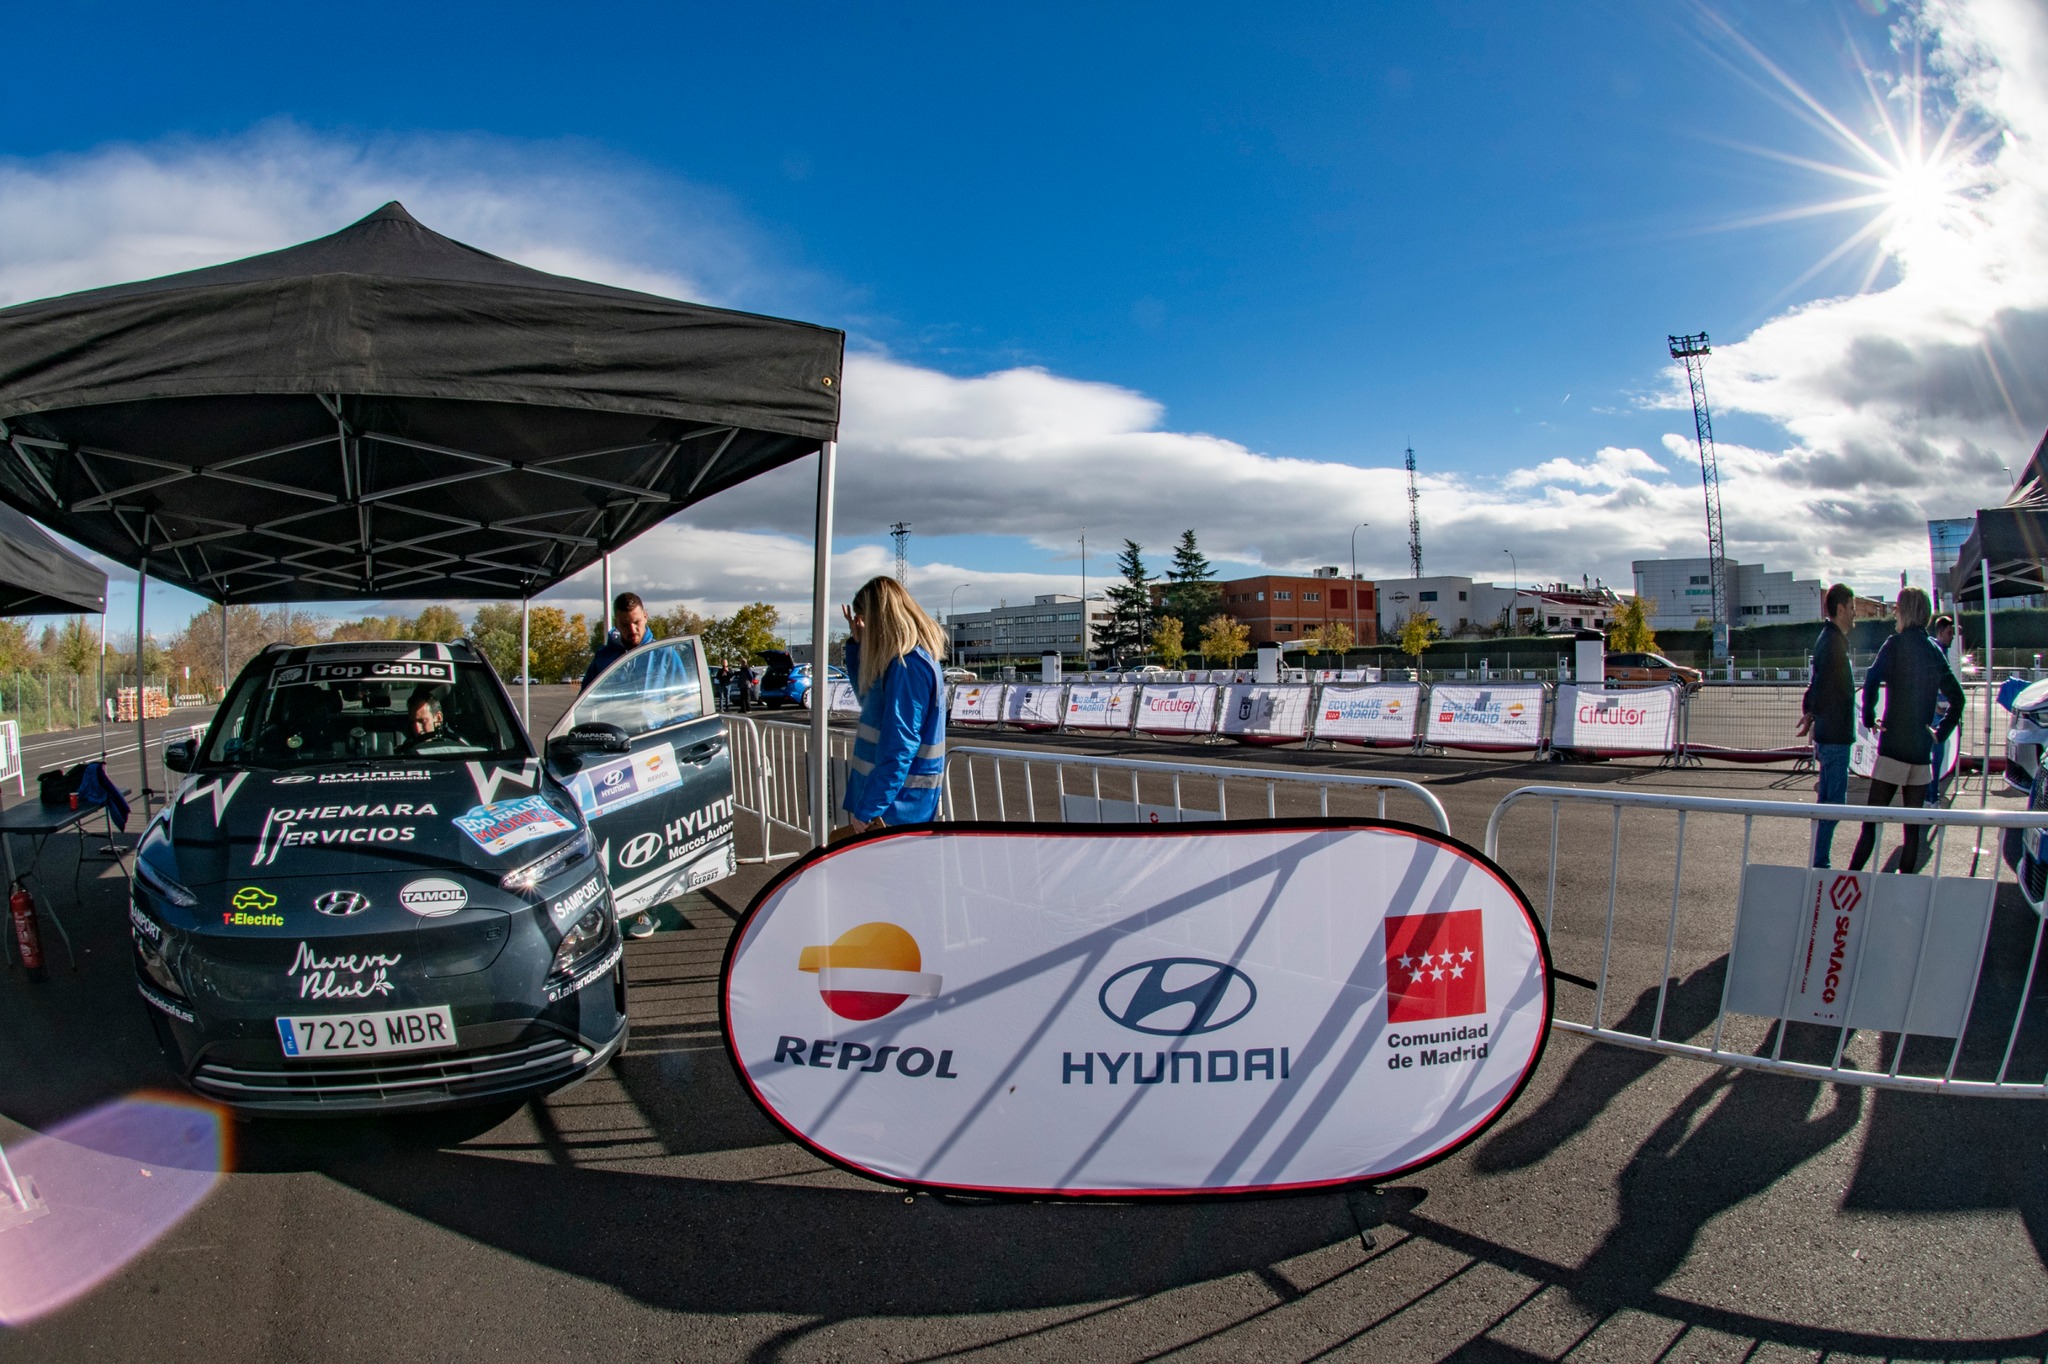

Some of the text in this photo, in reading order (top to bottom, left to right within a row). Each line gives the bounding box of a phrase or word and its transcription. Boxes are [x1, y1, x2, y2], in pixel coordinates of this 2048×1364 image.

[317, 663, 446, 677] Top Cable
[962, 708, 982, 716] REPSOL
[1151, 698, 1197, 713] Circutor
[1328, 699, 1382, 710] ECO RALLYE
[1340, 708, 1379, 720] MADRID
[1578, 704, 1647, 725] Circutor
[1453, 712, 1499, 724] MADRID
[319, 770, 431, 780] HYUNDAI
[601, 782, 631, 799] HYUNDAI
[460, 817, 496, 832] ECO
[493, 796, 549, 822] RALLYE
[473, 809, 543, 844] MADRID
[668, 836, 706, 861] Marcos
[402, 890, 466, 902] TAMOIL
[554, 877, 601, 919] SAMPORT
[223, 913, 284, 926] T-Electric
[1821, 915, 1850, 1004] SUMACO
[300, 970, 377, 999] Blue
[299, 1020, 378, 1051] 7229
[385, 1012, 447, 1046] MBR
[1387, 1023, 1489, 1049] Comunidad
[773, 1034, 958, 1080] REPSOL
[1062, 1046, 1289, 1085] HYUNDAI
[1387, 1043, 1489, 1070] de Madrid
